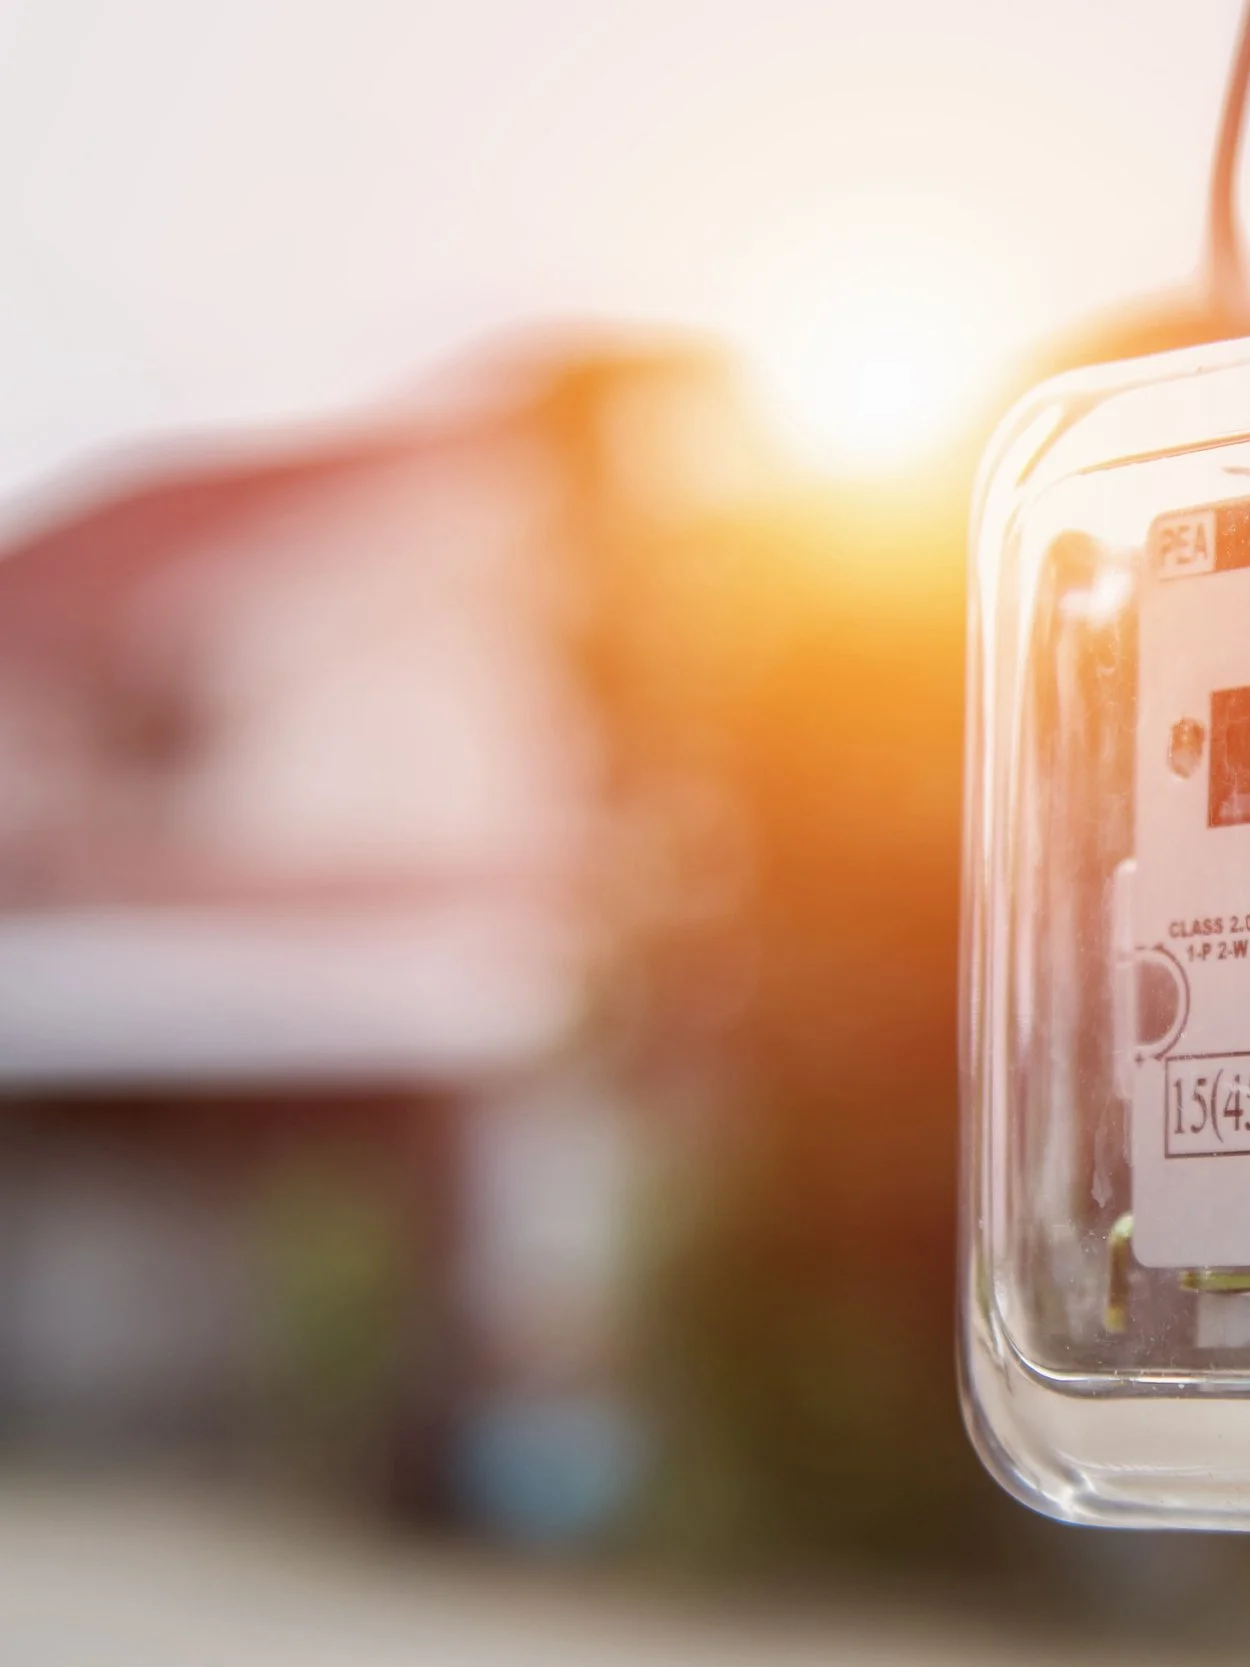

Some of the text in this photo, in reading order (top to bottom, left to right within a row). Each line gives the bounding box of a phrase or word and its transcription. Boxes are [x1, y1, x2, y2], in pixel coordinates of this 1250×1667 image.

[1160, 522, 1208, 567] PEA
[1168, 918, 1223, 938] CLASS
[1186, 940, 1248, 961] 1-P 2-W
